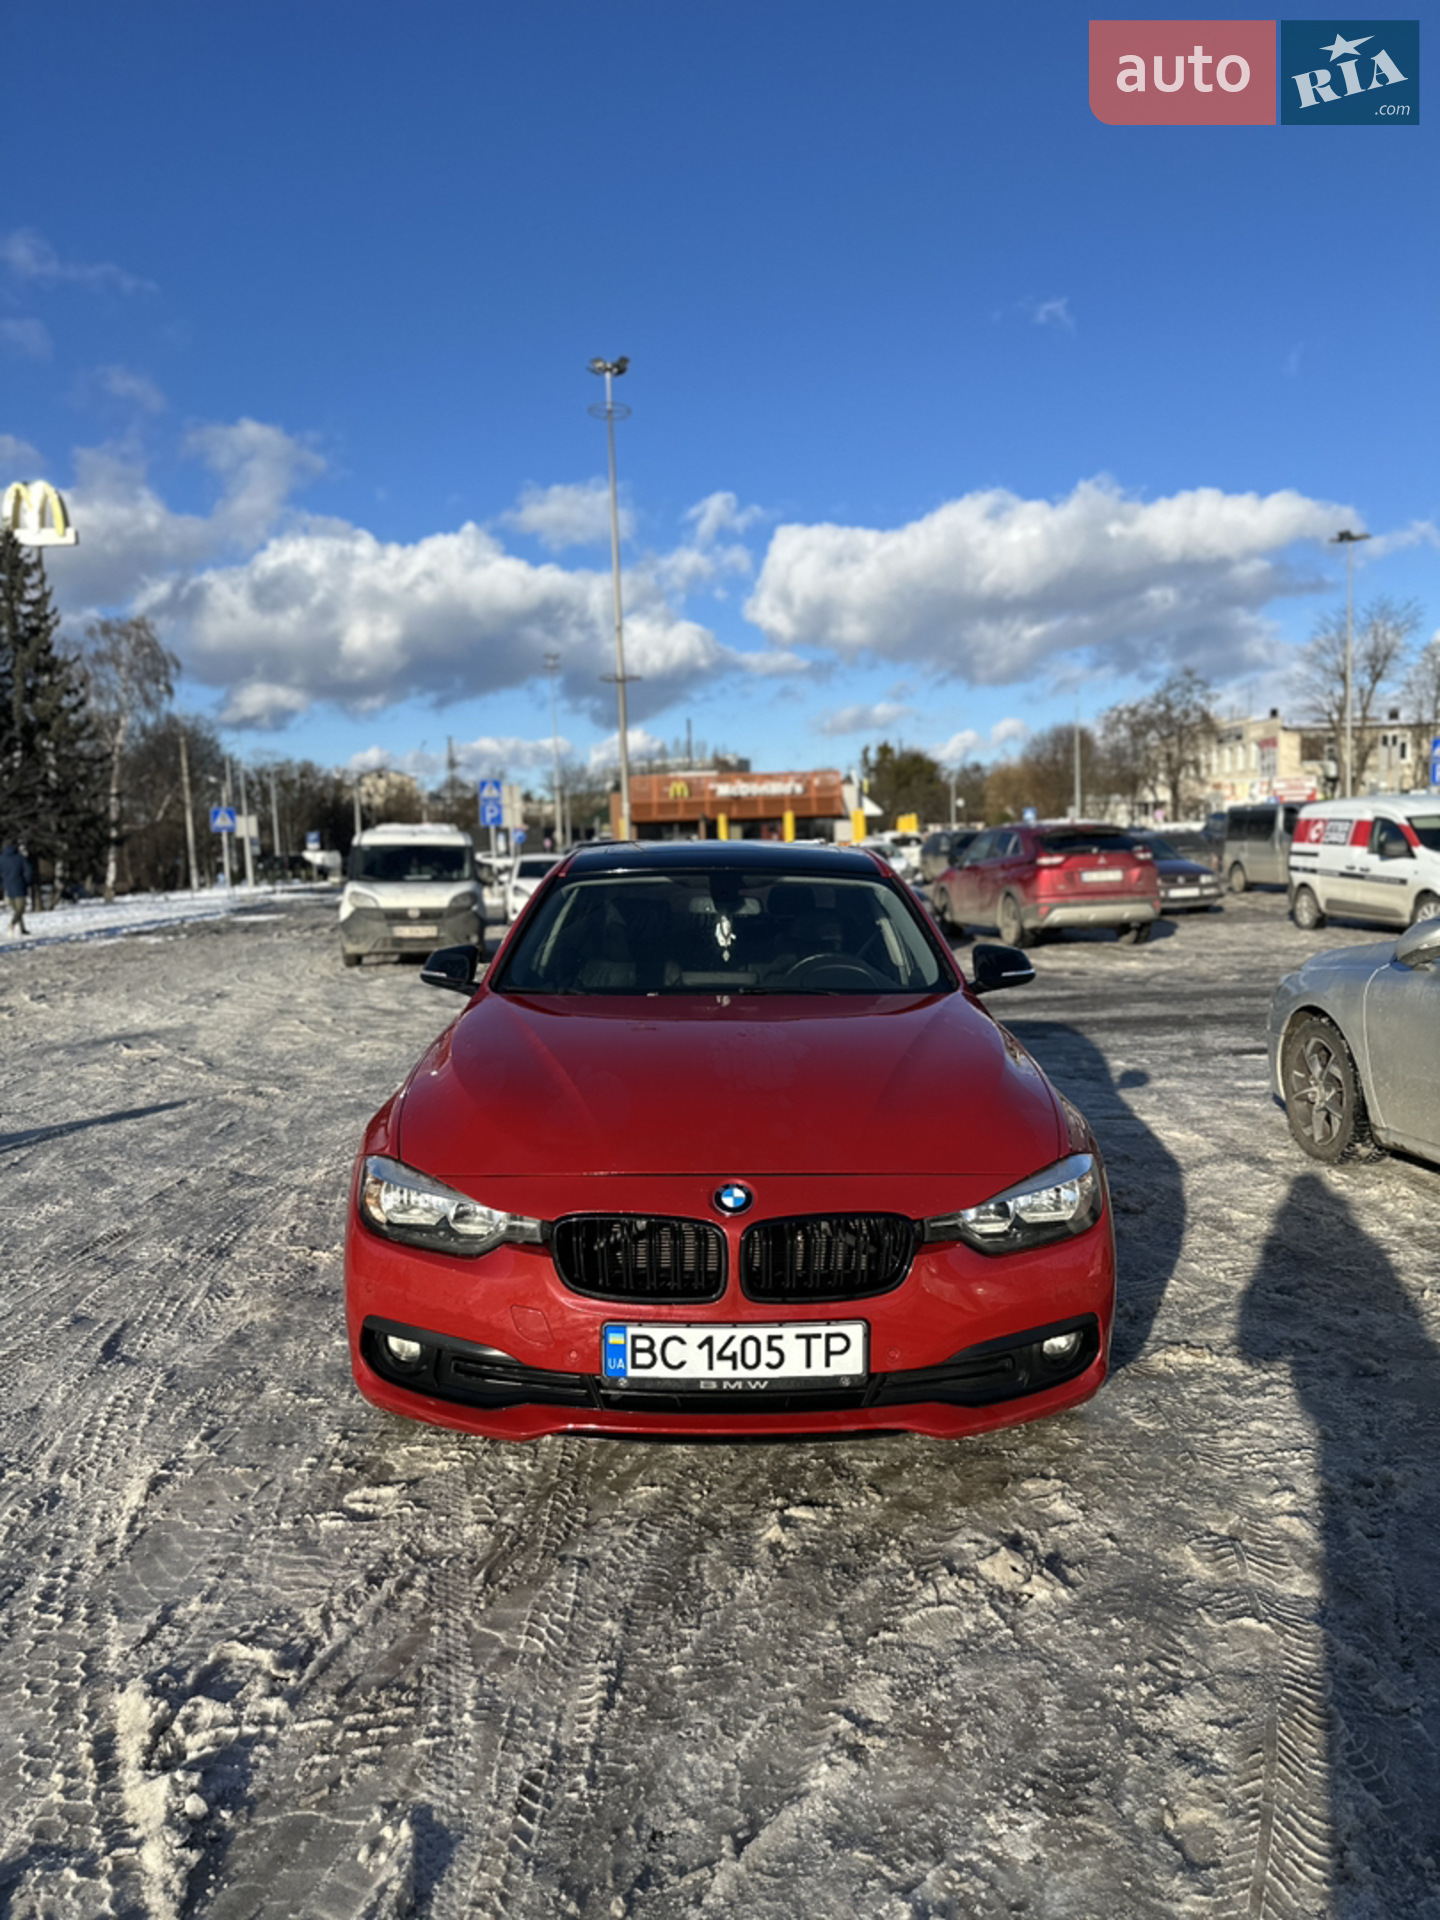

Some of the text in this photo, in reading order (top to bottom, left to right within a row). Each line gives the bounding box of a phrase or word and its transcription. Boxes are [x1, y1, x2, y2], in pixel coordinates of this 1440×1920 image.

[630, 1332, 852, 1371] BC 1405 TP
[608, 1359, 626, 1370] UA
[700, 1380, 769, 1390] BMW
